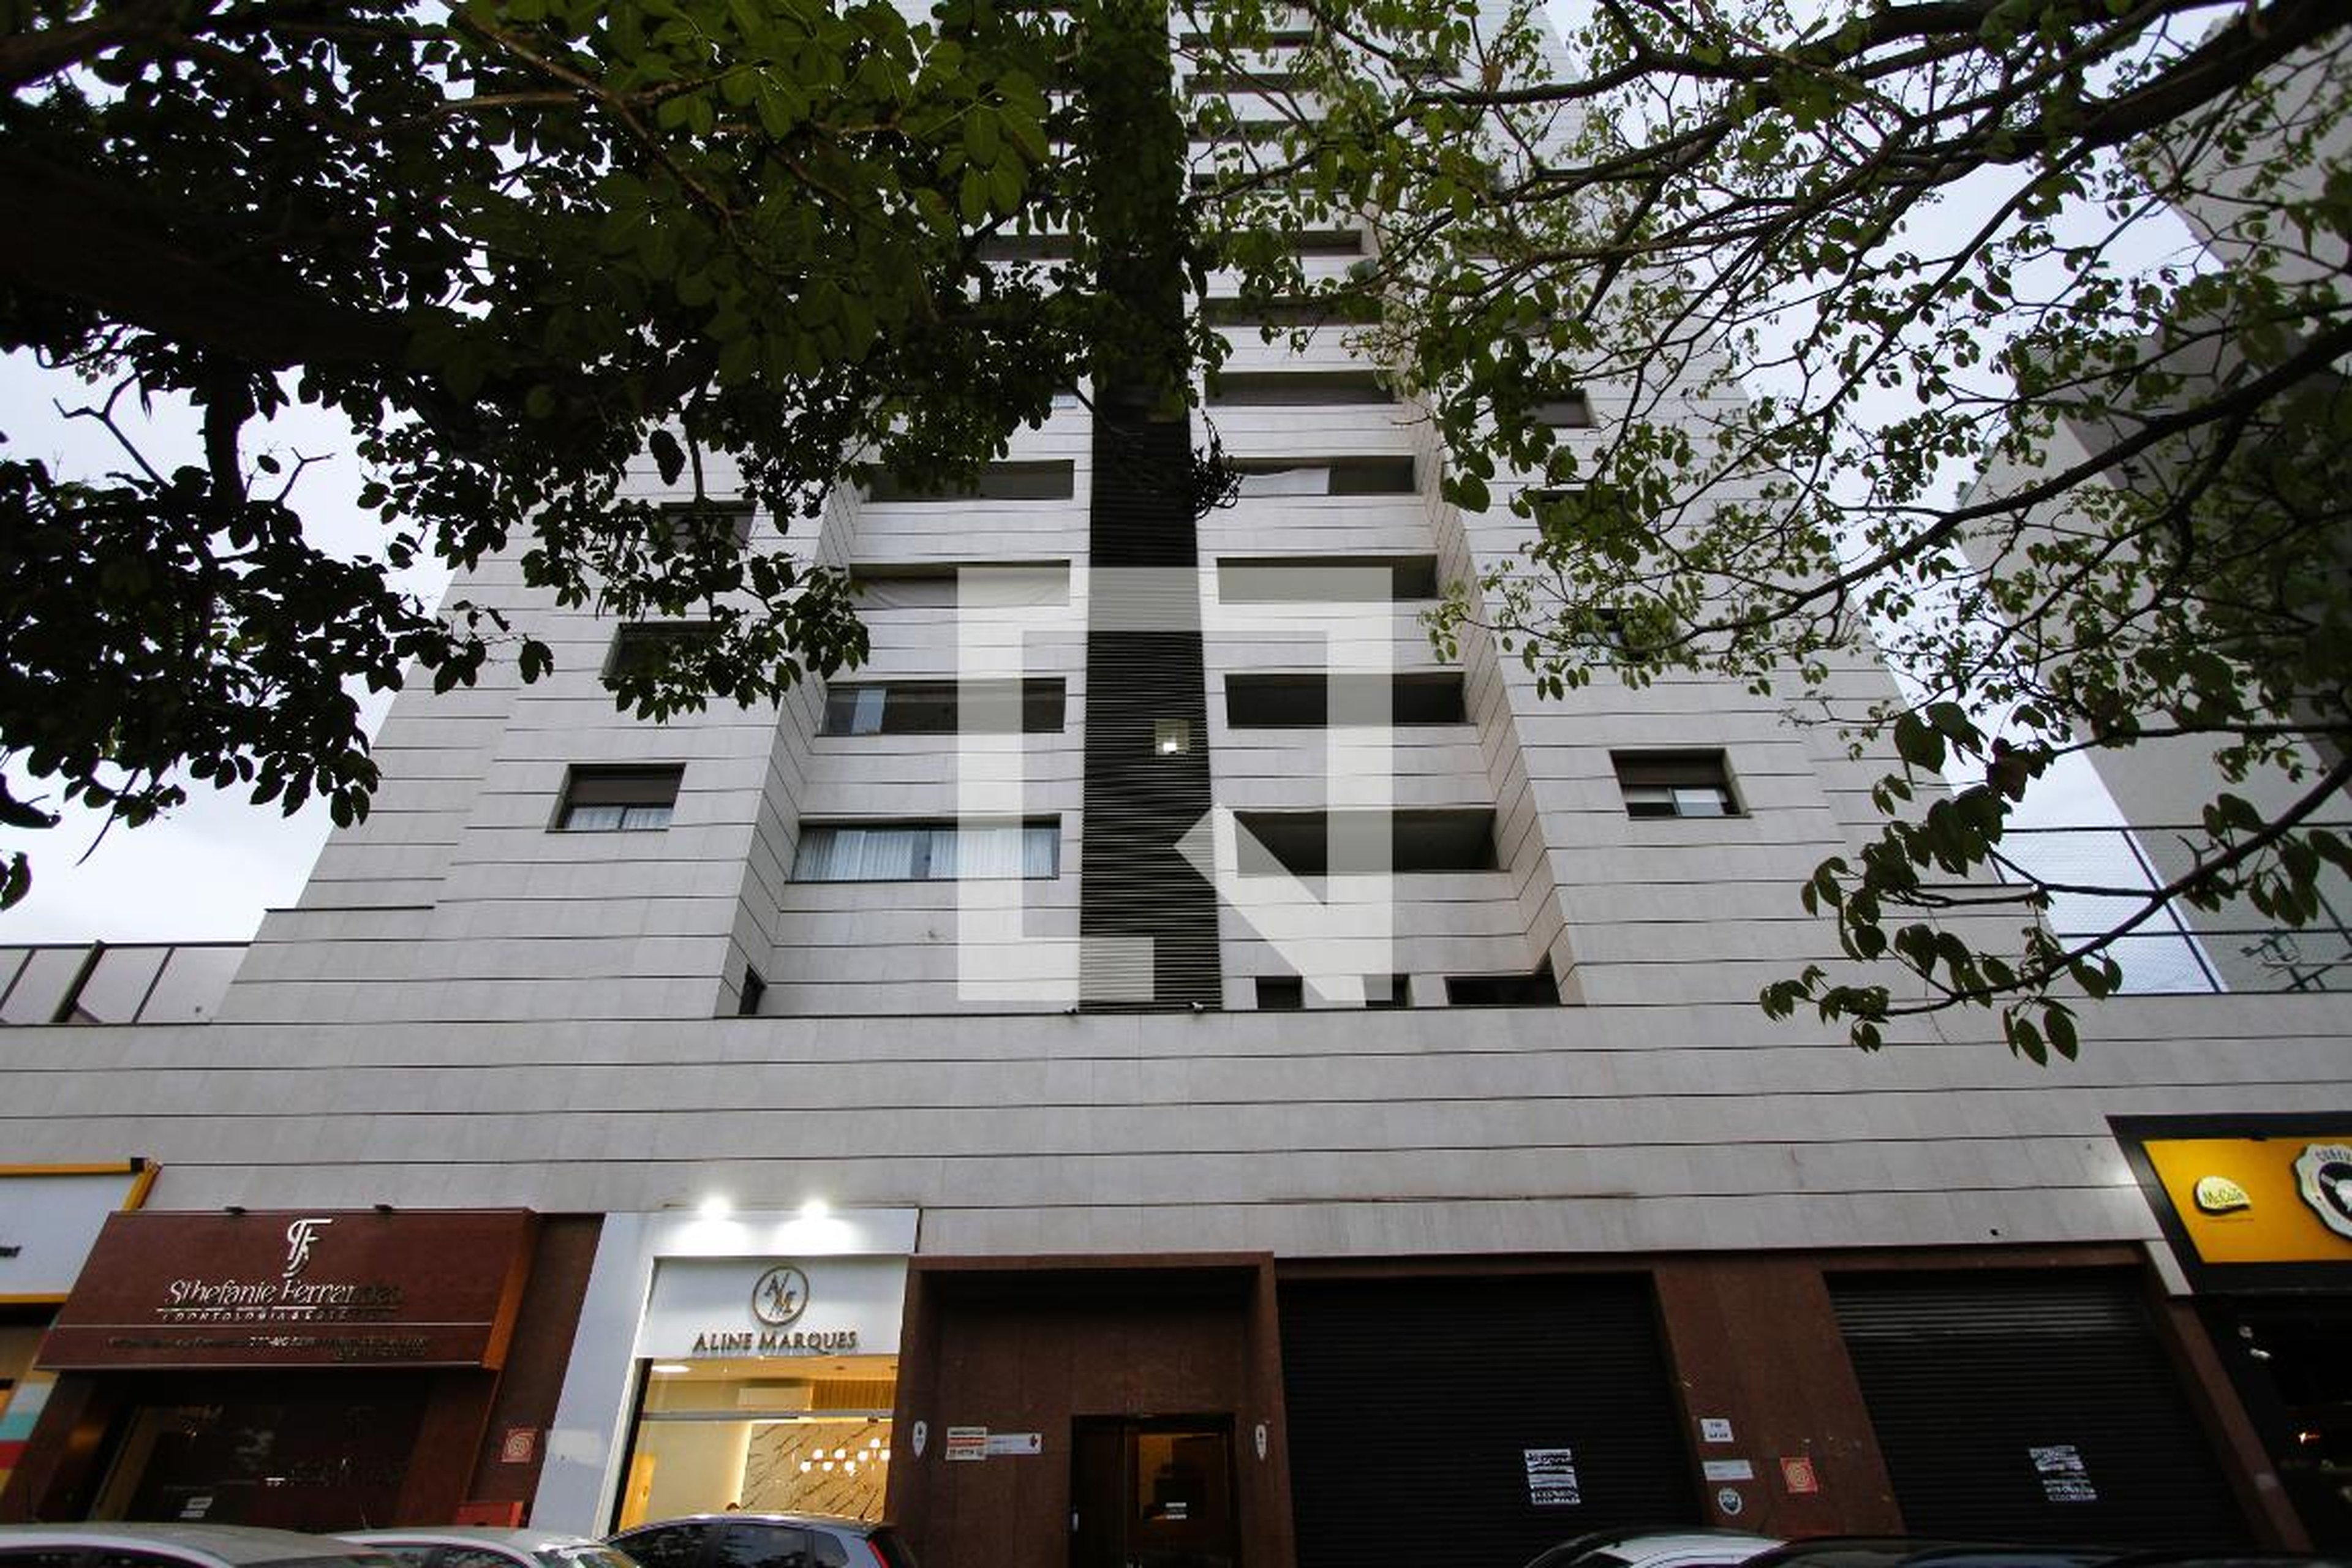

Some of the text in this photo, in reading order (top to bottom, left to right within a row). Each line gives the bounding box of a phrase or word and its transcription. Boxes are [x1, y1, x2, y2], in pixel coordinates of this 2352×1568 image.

[165, 1280, 277, 1304] Sthefanie
[692, 1331, 858, 1355] ALINE MARQUES
